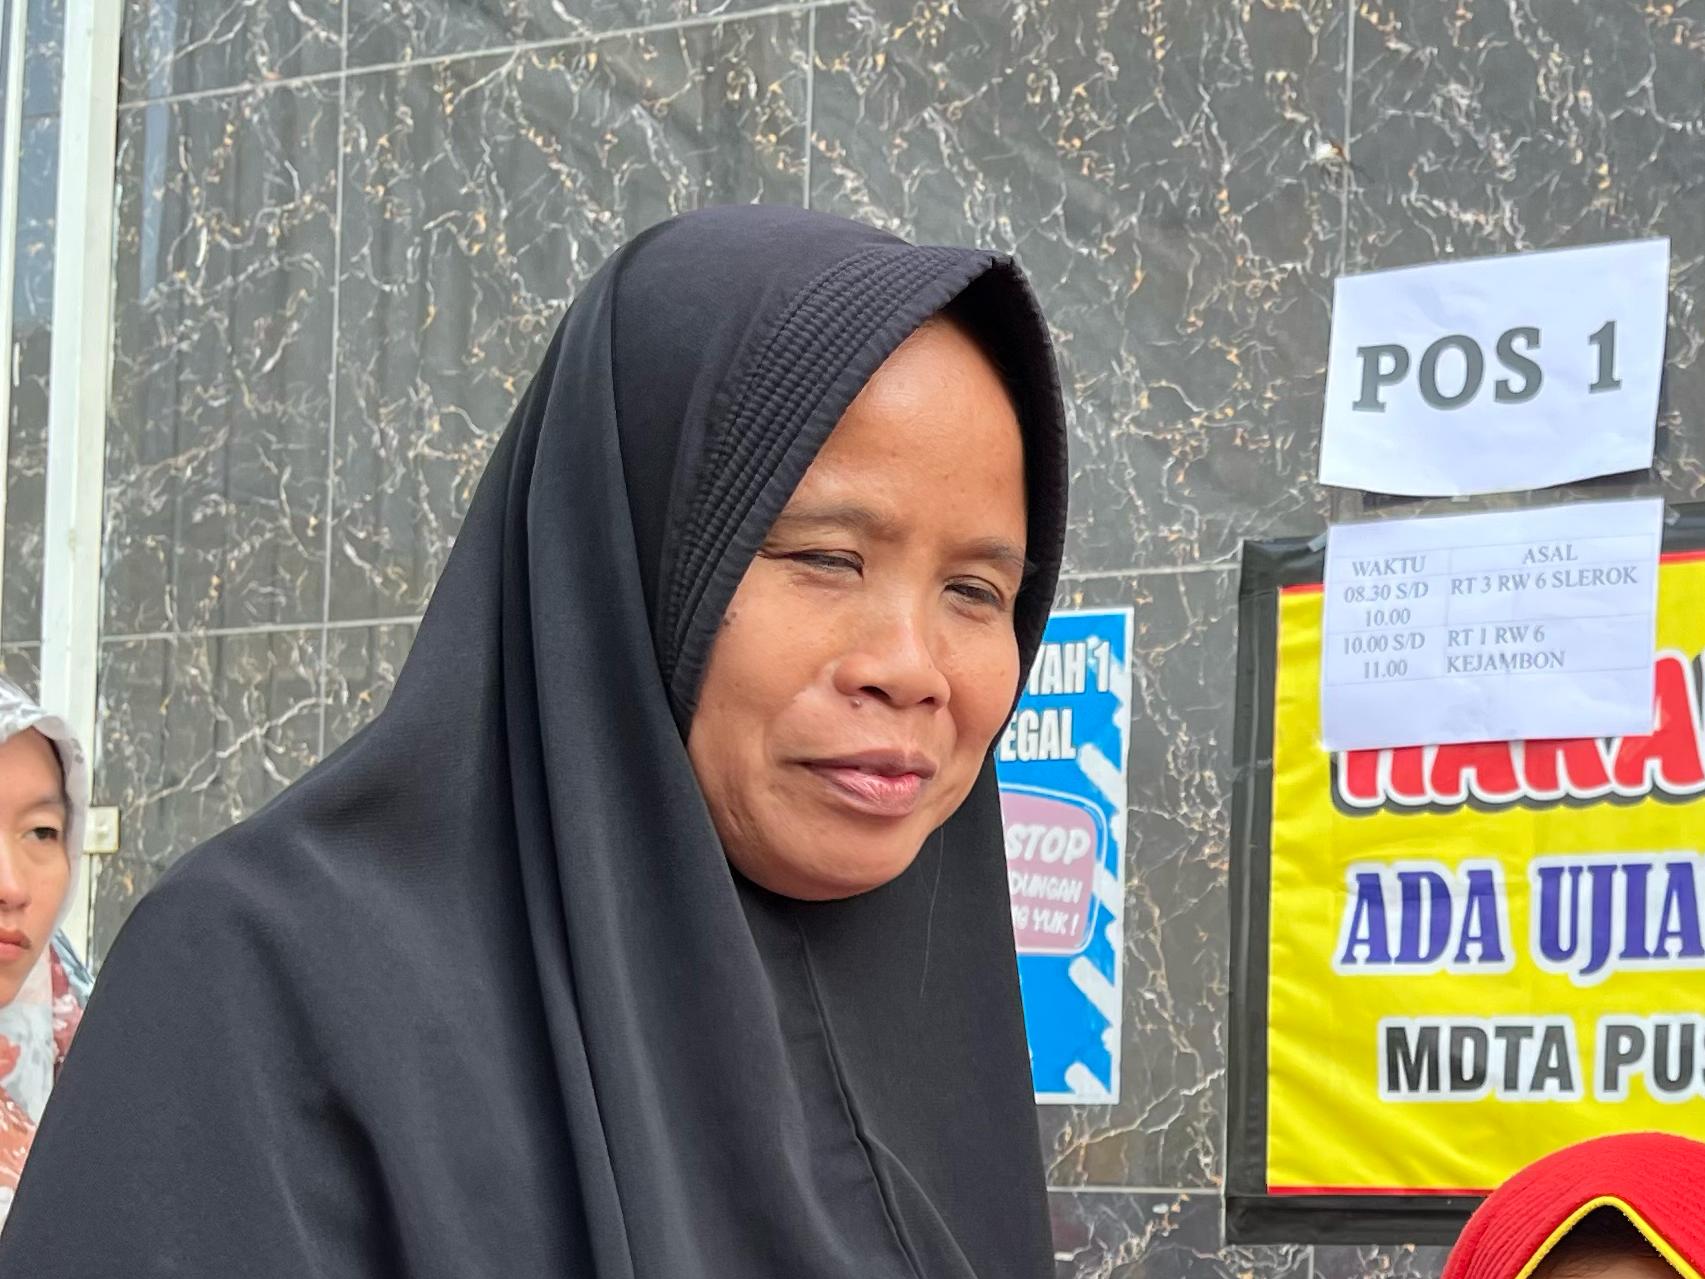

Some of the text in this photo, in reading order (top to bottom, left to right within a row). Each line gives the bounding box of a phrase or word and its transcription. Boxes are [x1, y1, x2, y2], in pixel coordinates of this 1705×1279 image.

[1352, 319, 1622, 414] POS 1
[1352, 555, 1426, 577] WAKTU
[1522, 544, 1579, 565] ASAL
[1343, 581, 1429, 604] 08.30 S/D
[1450, 565, 1639, 596] RT 3 RW 6 SLEROK
[1366, 607, 1411, 628] 10.00
[1343, 631, 1426, 655] 10.00 S/D
[1447, 624, 1546, 648] RT 1 RW 6
[1093, 640, 1110, 693] 1
[1363, 658, 1409, 679] 11.00
[1446, 650, 1567, 674] KEJAMBON
[999, 707, 1078, 763] EGAL
[1005, 823, 1092, 866] STOP
[1340, 868, 1508, 966] ADA
[1385, 1024, 1577, 1094] MDTA
